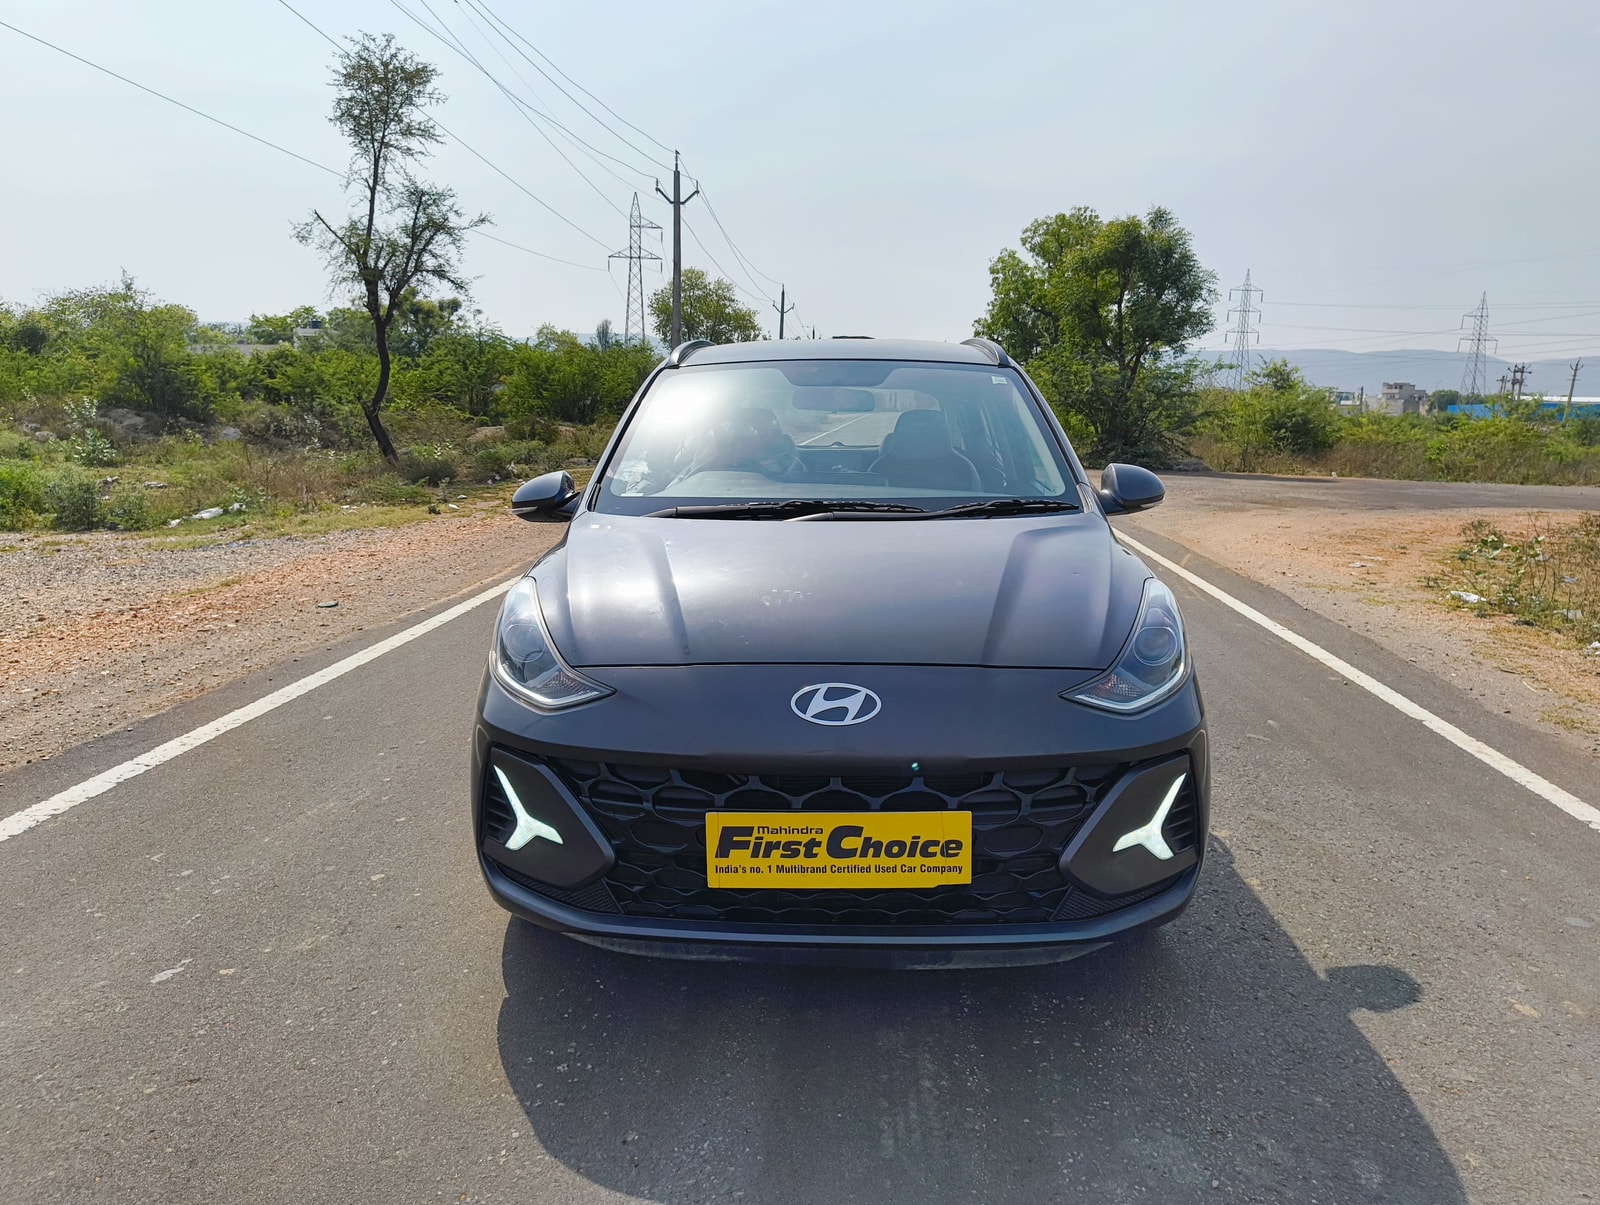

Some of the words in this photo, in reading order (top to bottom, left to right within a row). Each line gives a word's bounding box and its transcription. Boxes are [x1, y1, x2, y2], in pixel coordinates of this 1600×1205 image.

[757, 825, 824, 835] Mahindra
[714, 825, 823, 859] First
[825, 824, 963, 859] Choice
[715, 863, 747, 874] India's
[749, 866, 764, 874] no.
[767, 864, 772, 874] 1
[775, 864, 827, 874] Multibrand
[829, 863, 872, 874] Certified
[874, 863, 898, 874] Used
[900, 863, 917, 873] Car
[919, 863, 963, 875] Company
